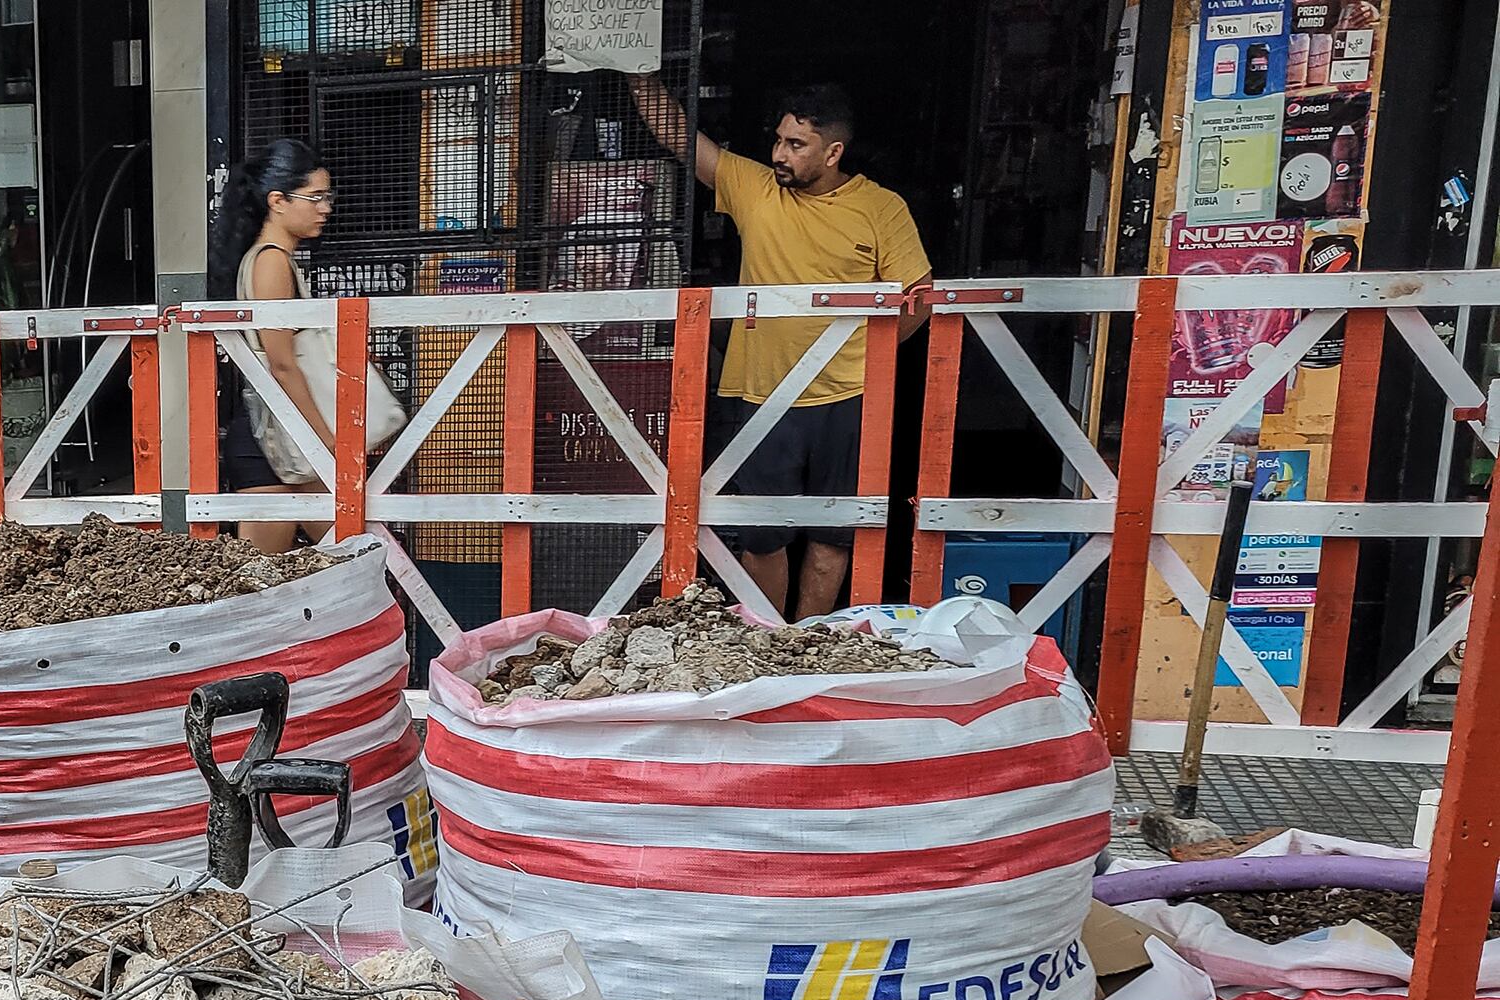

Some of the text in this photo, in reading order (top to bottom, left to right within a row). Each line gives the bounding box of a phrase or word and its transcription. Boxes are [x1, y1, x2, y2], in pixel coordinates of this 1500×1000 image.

[1297, 6, 1328, 16] PRECIO
[547, 15, 584, 30] YOGUR
[1297, 17, 1325, 28] AMIGO
[594, 31, 654, 50] NATURAL
[1301, 103, 1330, 114] pepsi
[1194, 196, 1219, 206] RUBIA
[1178, 239, 1295, 250] ULTRA WATERMELON
[1173, 380, 1216, 388] FULL
[1189, 408, 1210, 417] Las
[1257, 457, 1281, 469] RGÁ
[1248, 535, 1310, 547] personal
[1272, 574, 1298, 584] DÍAS
[1273, 615, 1295, 624] Chip
[1251, 648, 1292, 661] sonal
